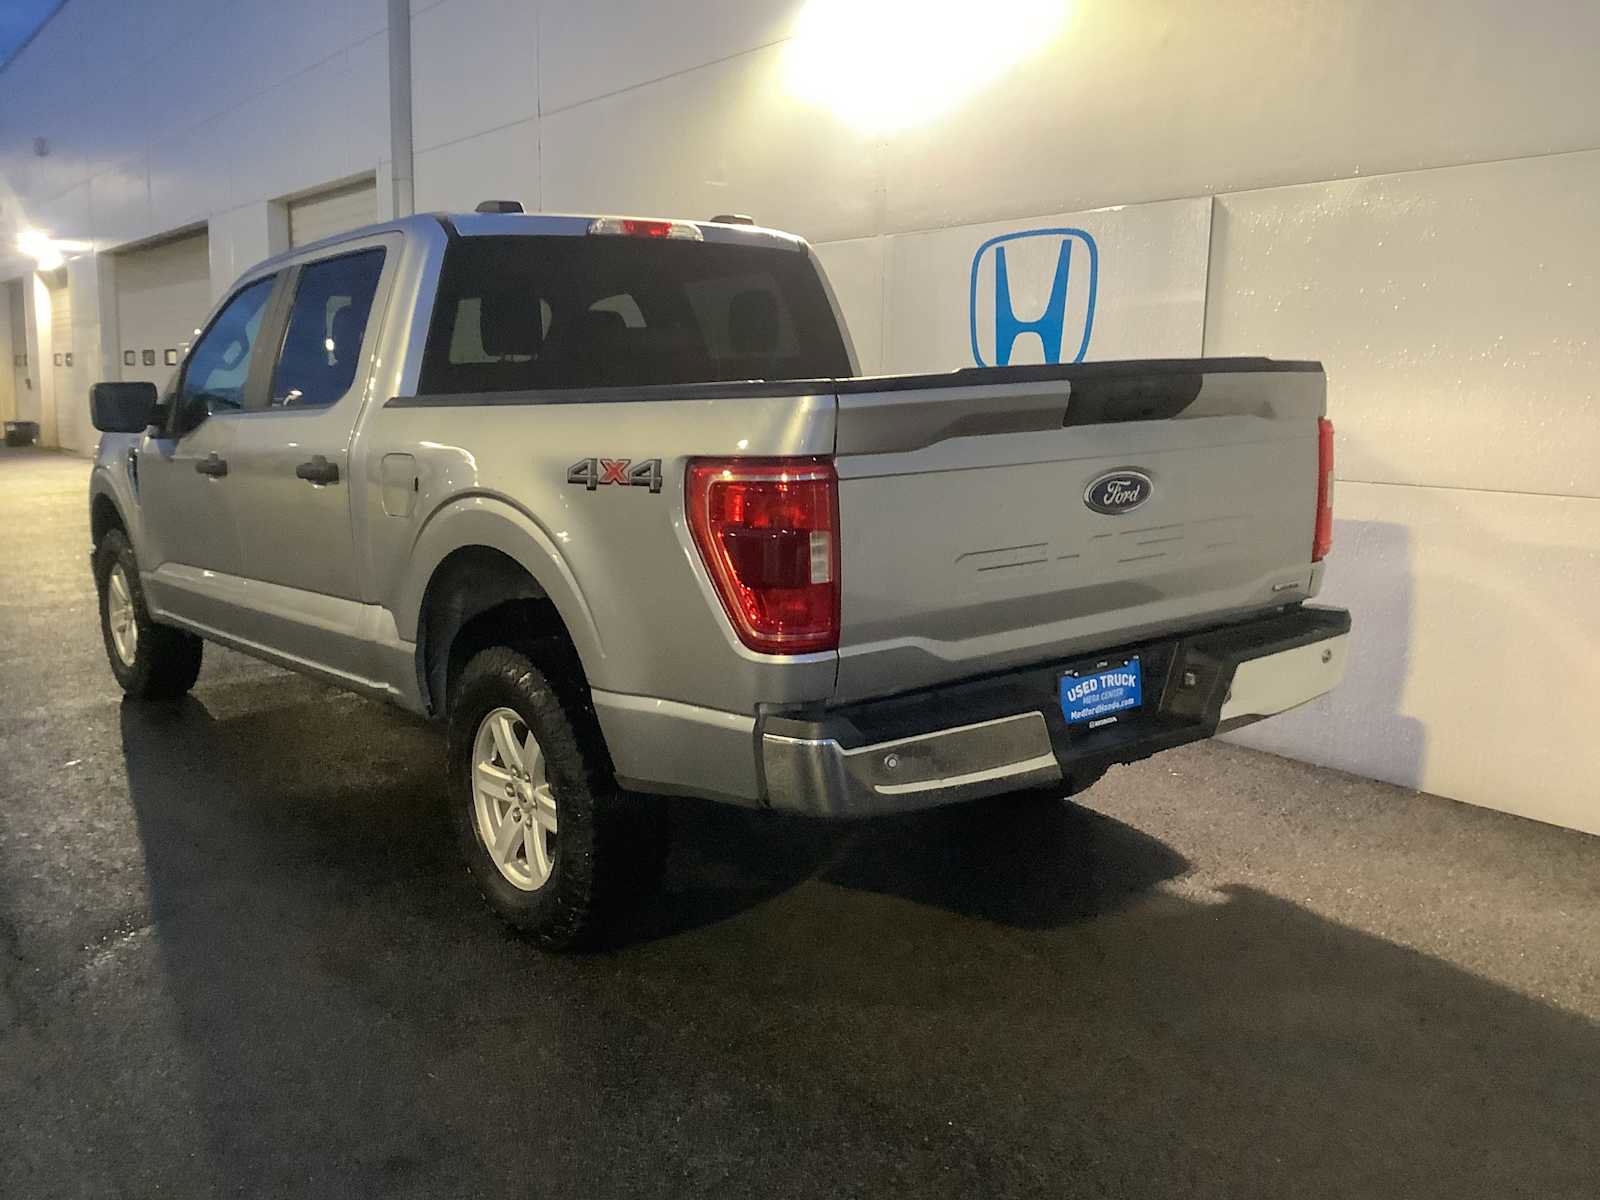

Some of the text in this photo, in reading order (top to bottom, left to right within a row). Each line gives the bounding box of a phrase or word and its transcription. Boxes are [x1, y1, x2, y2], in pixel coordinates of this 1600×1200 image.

[1103, 480, 1140, 504] Ford
[1067, 673, 1136, 702] USED TRUCK
